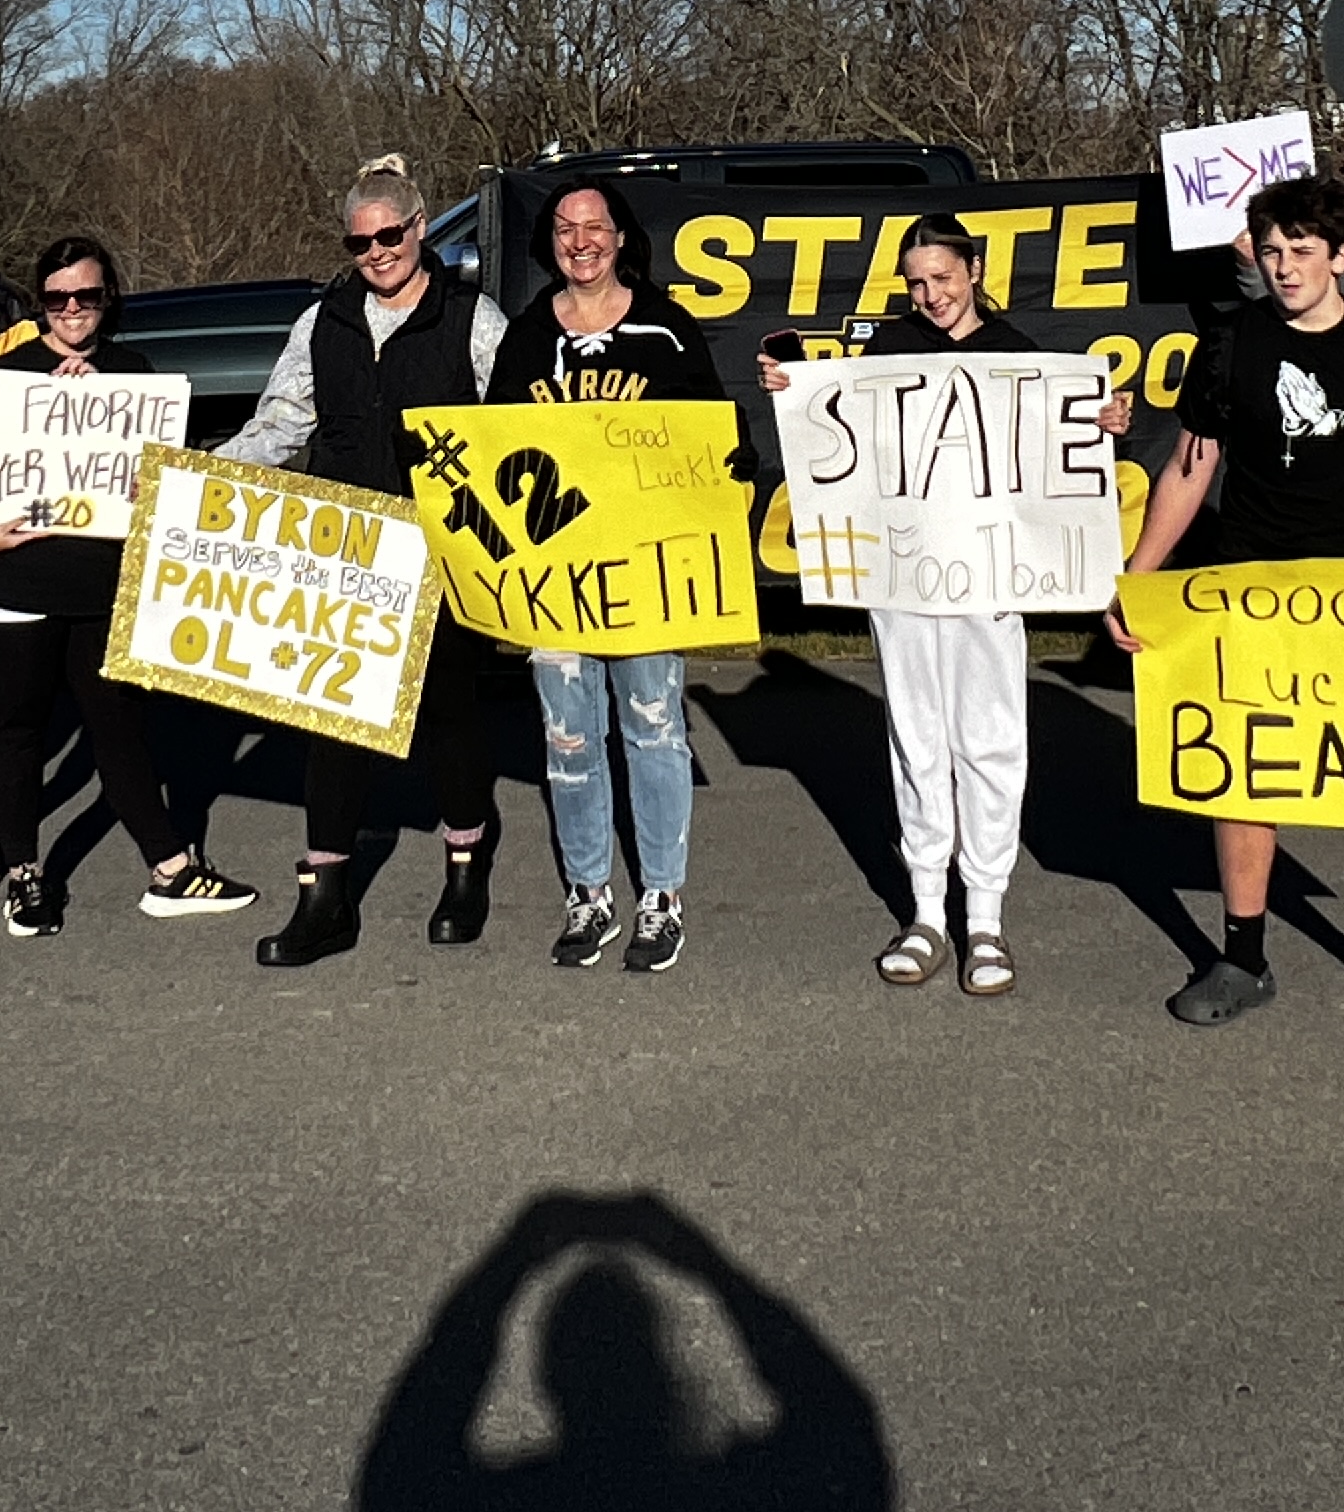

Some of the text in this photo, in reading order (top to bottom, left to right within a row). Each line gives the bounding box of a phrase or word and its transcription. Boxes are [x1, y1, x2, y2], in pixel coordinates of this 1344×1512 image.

[23, 383, 180, 441] FAVORITE
[529, 368, 648, 403] BYRON
[604, 414, 671, 449] Good
[807, 364, 1108, 499] STATE
[23, 496, 93, 528] #20
[196, 478, 384, 569] BYRON
[153, 558, 401, 657] PANCAKES
[339, 566, 412, 614] BEST
[441, 556, 636, 635] LYKKE
[170, 615, 362, 706] OL #72
